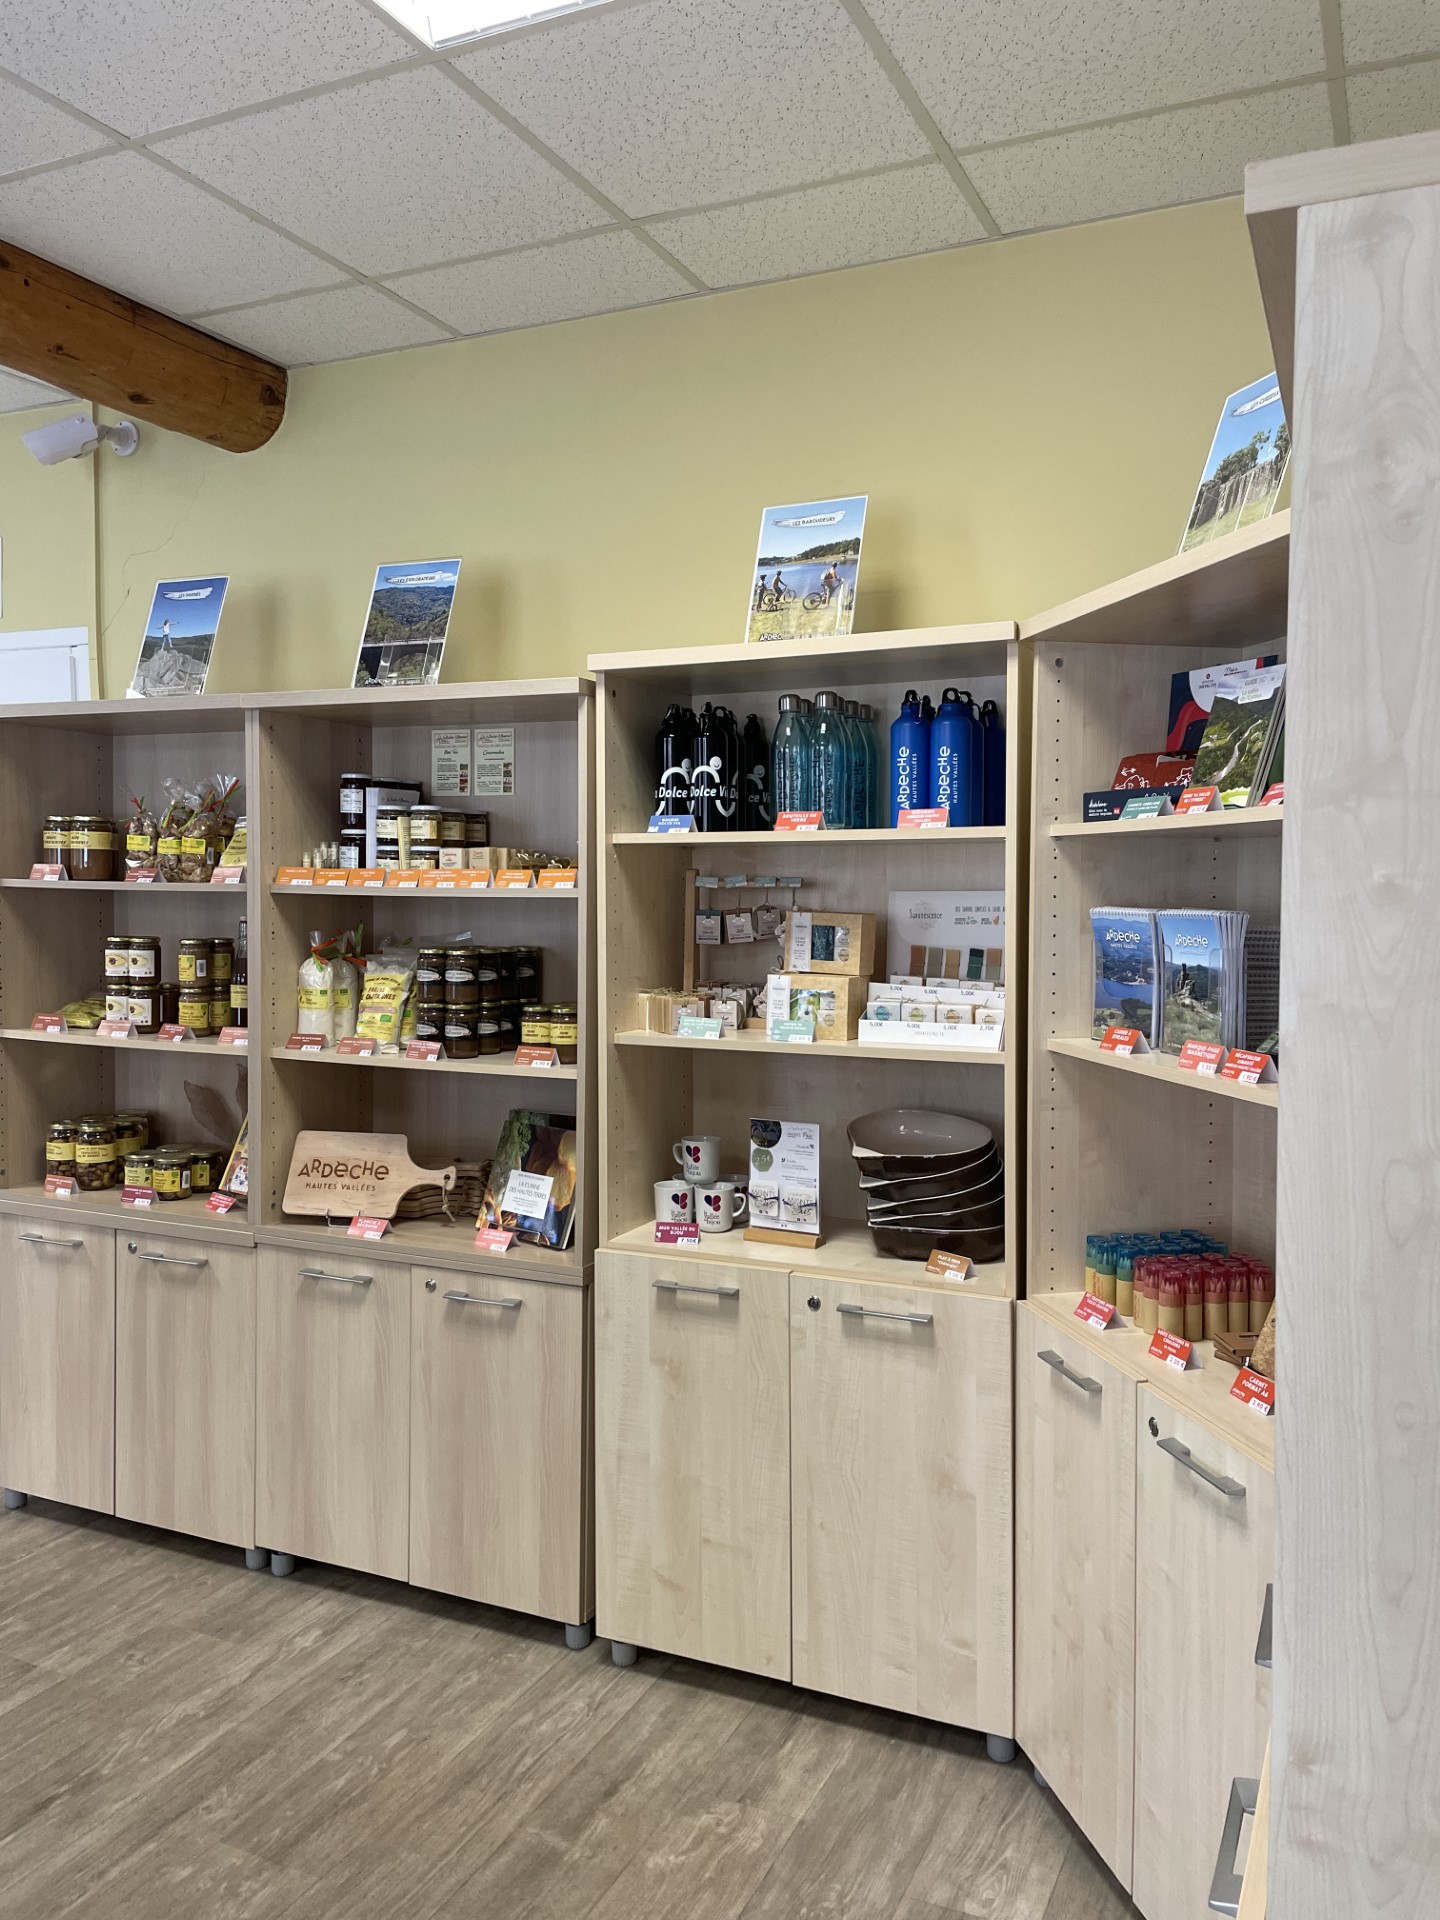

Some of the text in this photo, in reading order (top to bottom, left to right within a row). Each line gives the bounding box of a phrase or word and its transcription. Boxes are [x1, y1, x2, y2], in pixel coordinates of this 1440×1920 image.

[658, 785, 688, 798] Dolce
[690, 784, 717, 797] Dolce
[1187, 1043, 1220, 1054] MARQUE-PAGE
[305, 1182, 376, 1192] HAUTES VALLÉES
[1241, 1379, 1270, 1398] FORMAT A6
[1249, 1376, 1269, 1390] CARNET
